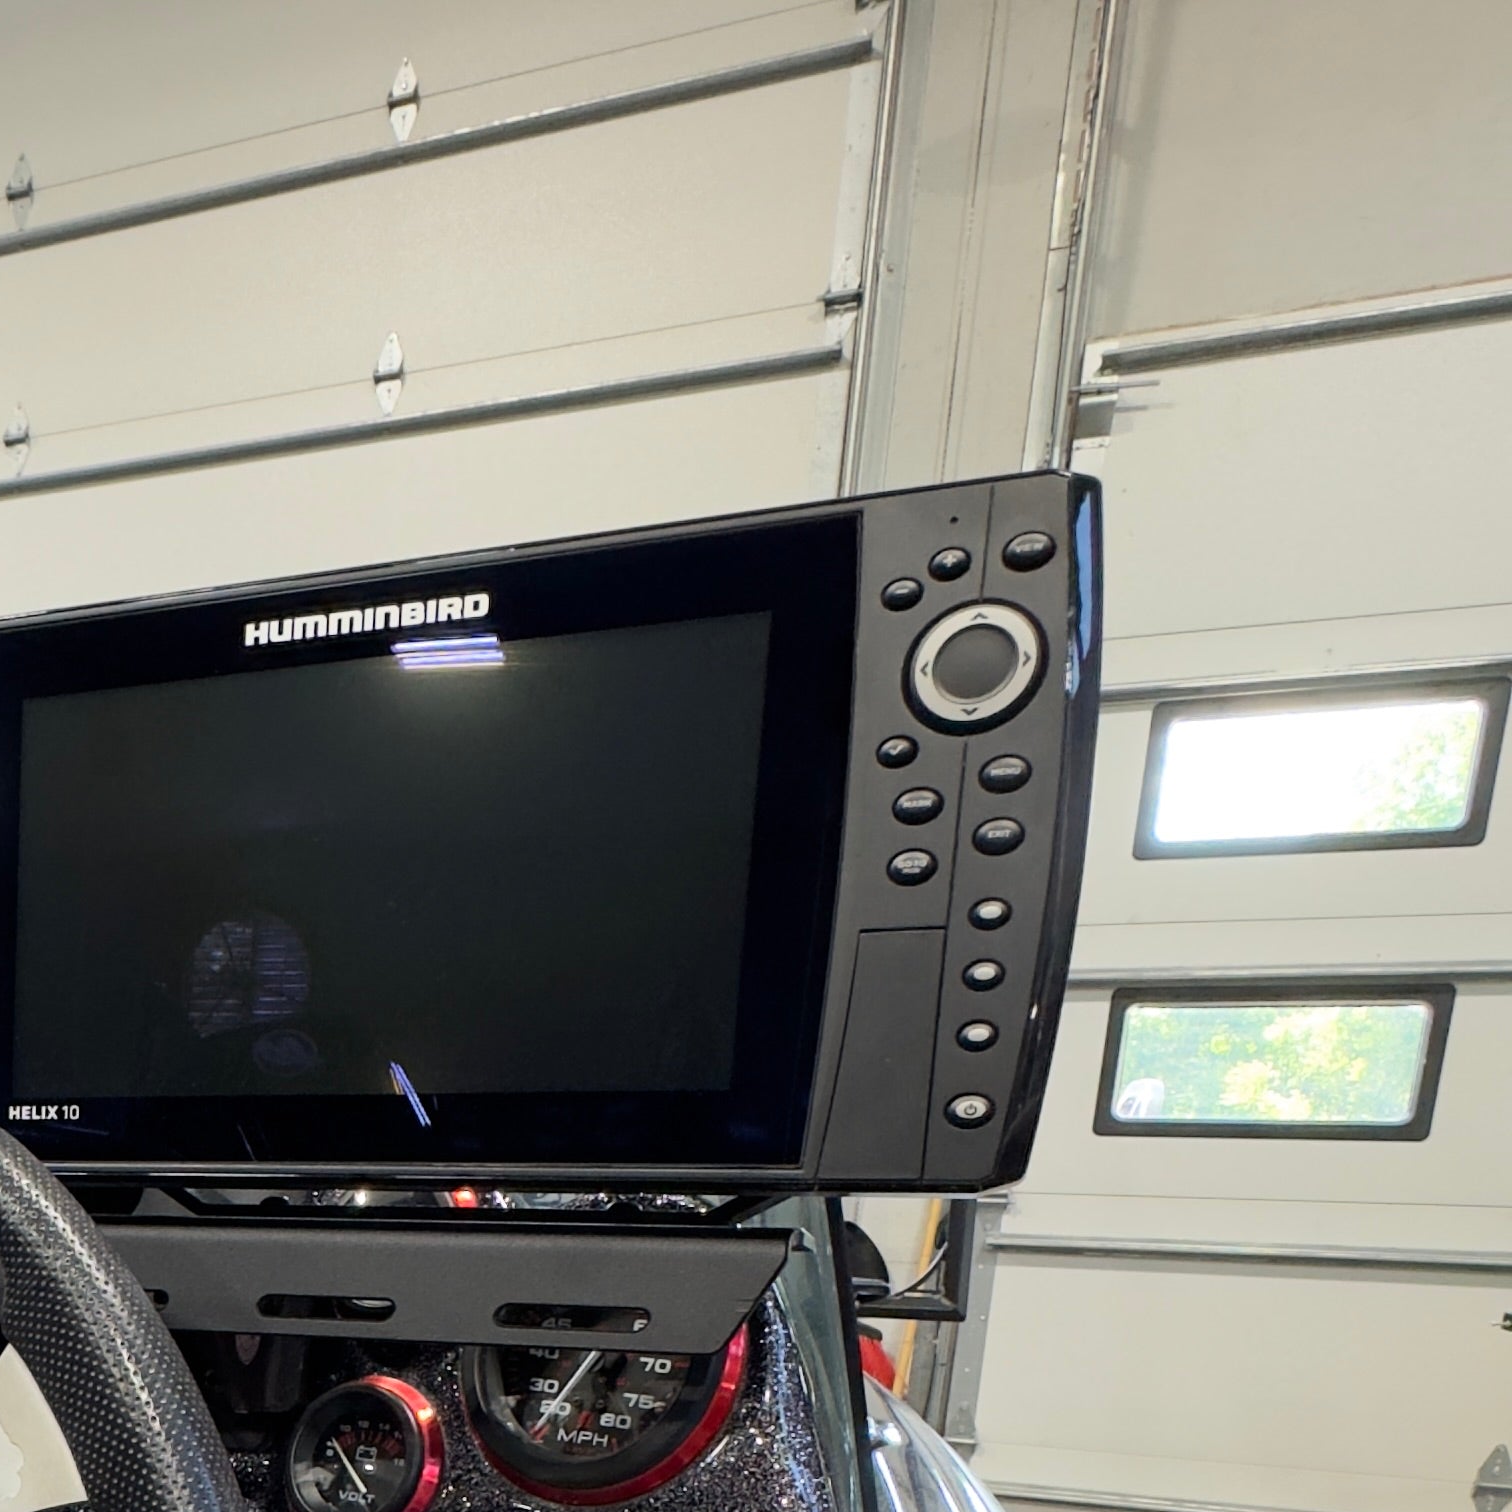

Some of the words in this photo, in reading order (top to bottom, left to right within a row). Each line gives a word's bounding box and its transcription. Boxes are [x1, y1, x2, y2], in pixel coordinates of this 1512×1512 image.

[244, 592, 490, 647] HUMMINBIRD
[8, 1105, 58, 1120] HELIX
[61, 1104, 80, 1120] 10
[639, 1357, 672, 1374] 70
[529, 1377, 560, 1394] 30
[623, 1392, 655, 1410] 75
[599, 1413, 632, 1430] 80
[556, 1427, 609, 1448] MPH
[338, 1489, 376, 1504] VOLT
